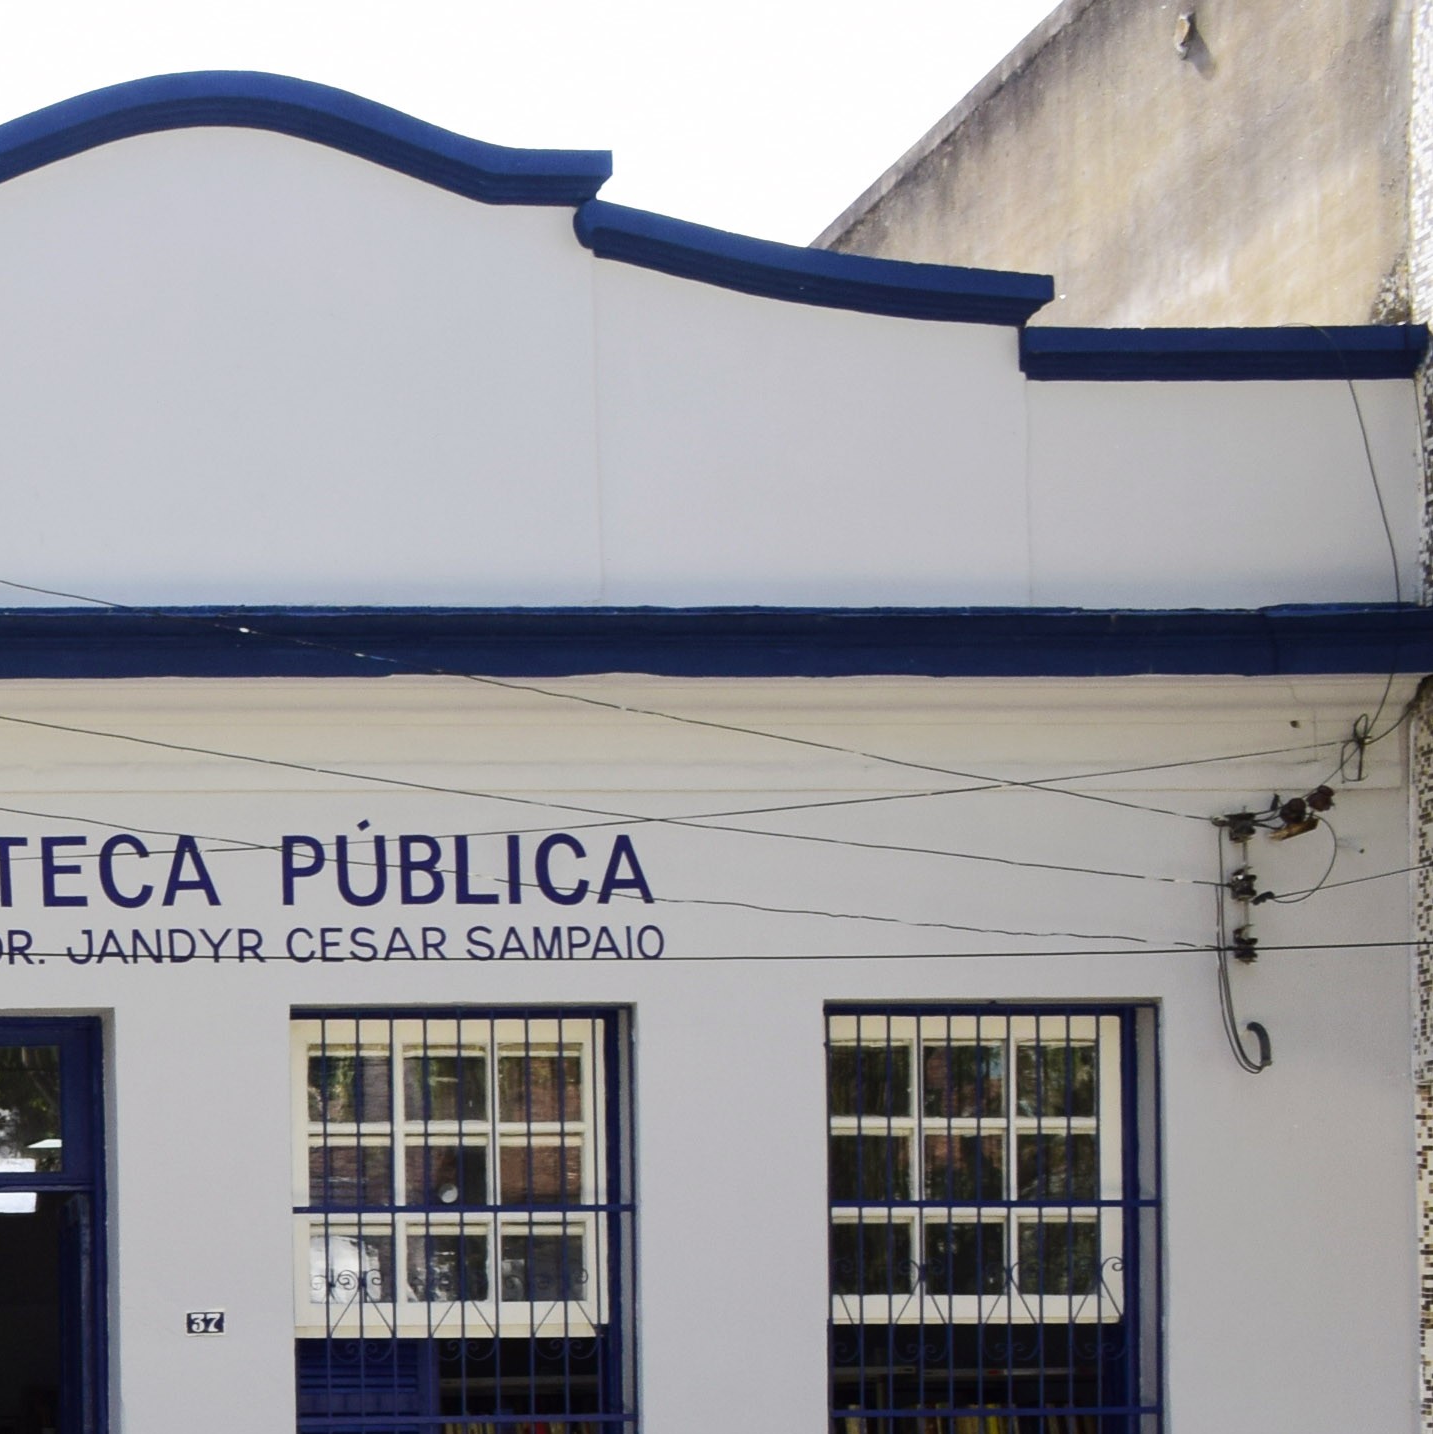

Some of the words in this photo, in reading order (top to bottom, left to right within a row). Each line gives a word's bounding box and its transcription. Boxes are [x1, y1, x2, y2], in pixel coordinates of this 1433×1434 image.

[282, 819, 655, 907] PÚBLICA
[67, 928, 266, 964] JANDYR
[286, 926, 448, 963] CESAR
[466, 924, 665, 961] SAMPAIO
[191, 1313, 221, 1332] 37
